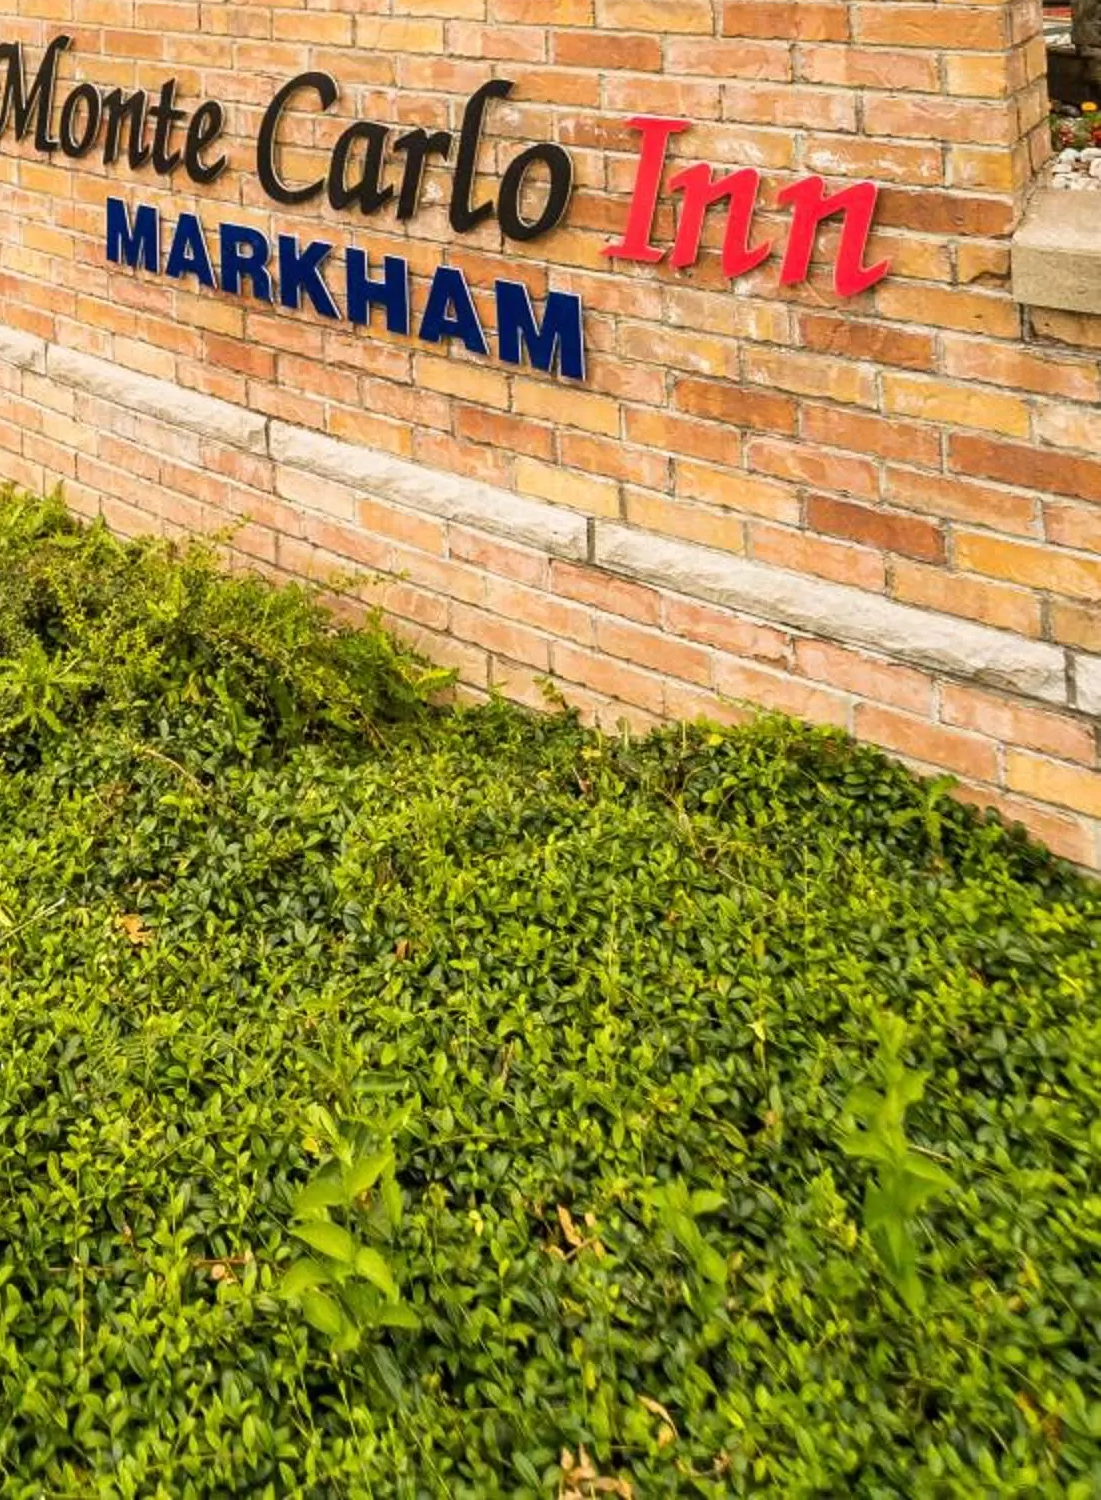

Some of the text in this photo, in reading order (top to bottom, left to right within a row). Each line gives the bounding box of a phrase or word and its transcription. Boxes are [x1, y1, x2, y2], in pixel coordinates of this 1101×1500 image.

[256, 71, 574, 242] Carlo
[601, 116, 891, 298] Inn
[106, 196, 586, 381] MARKHAM
